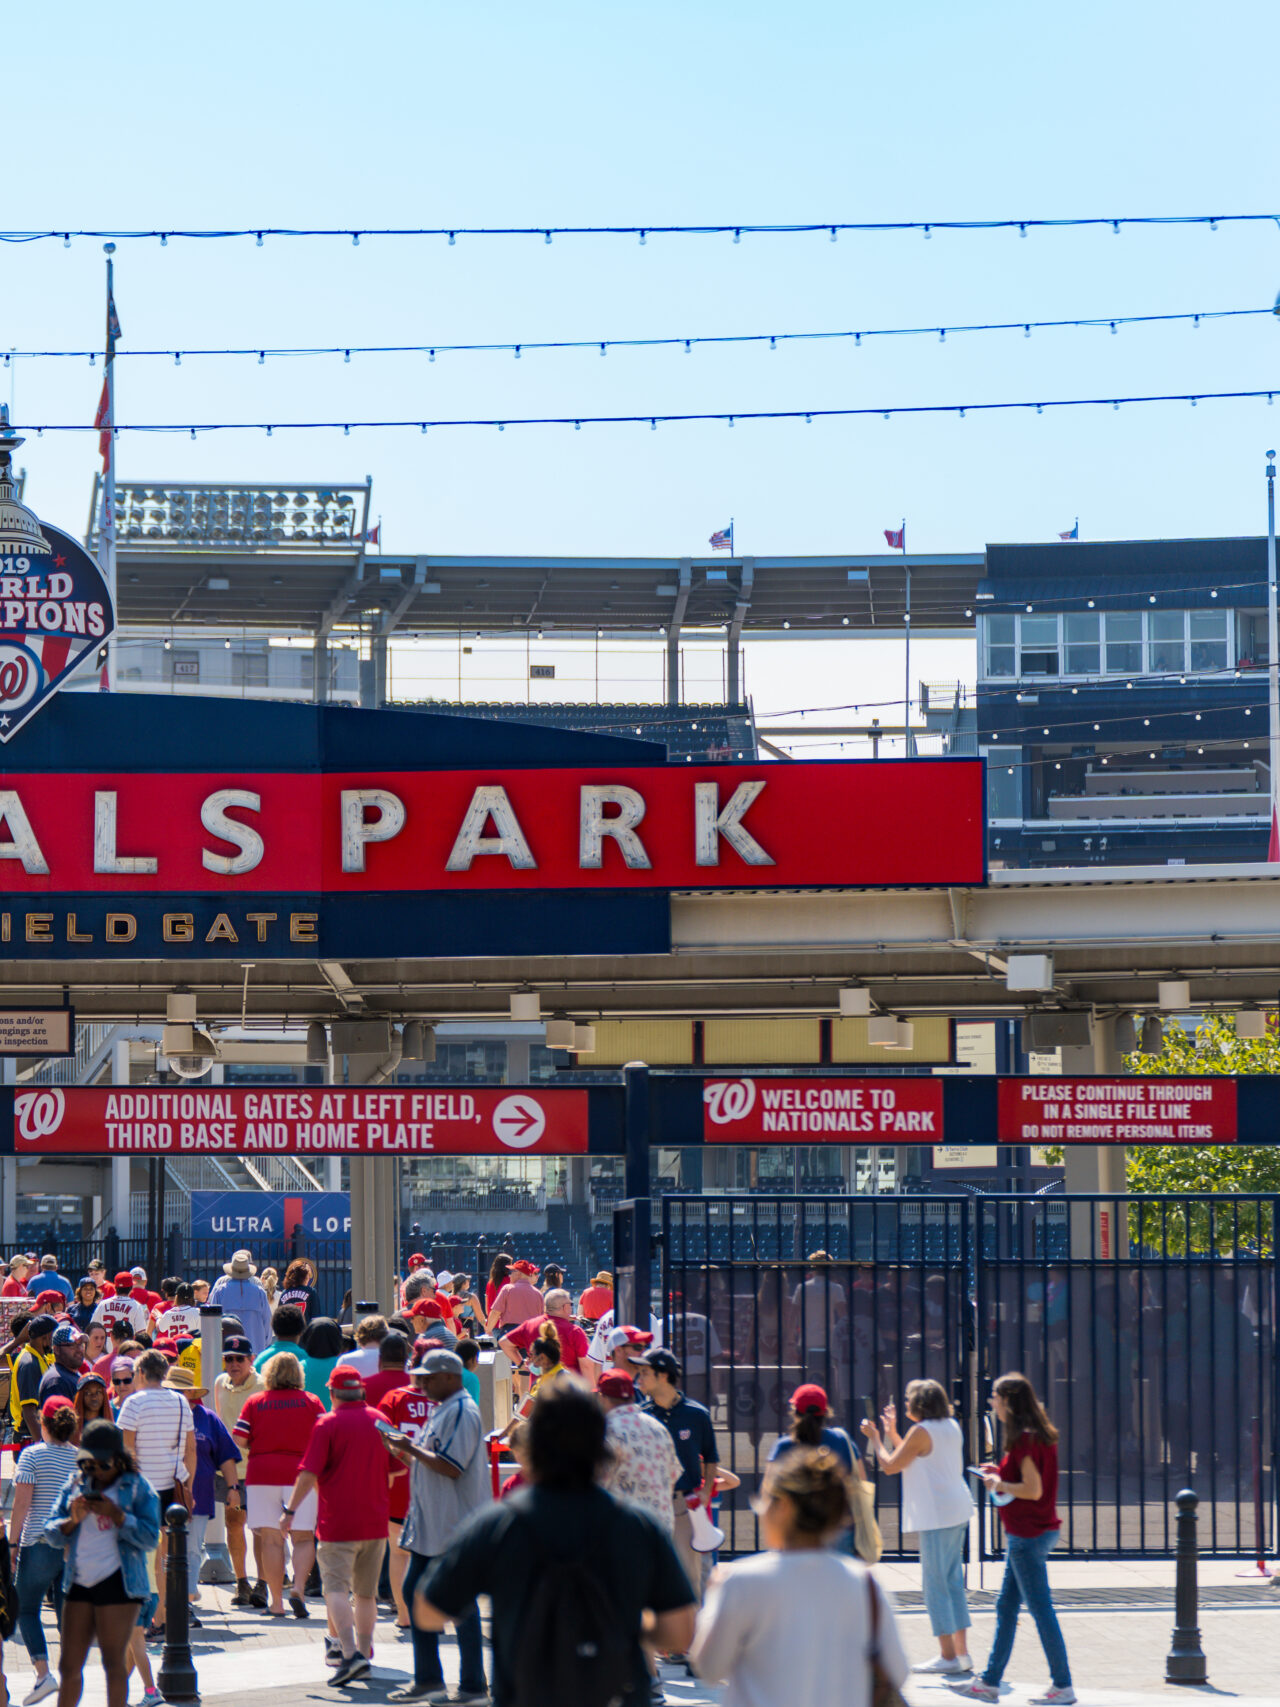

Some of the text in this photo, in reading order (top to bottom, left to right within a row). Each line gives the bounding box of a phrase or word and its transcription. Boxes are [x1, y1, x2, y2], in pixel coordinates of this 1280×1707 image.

[340, 780, 776, 874] PARK
[162, 911, 319, 943] GATE
[16, 1016, 44, 1025] and/or
[4, 1036, 48, 1047] inspection
[761, 1089, 896, 1110] WELCOME TO
[1021, 1084, 1213, 1101] PLEASE CONTINUE THROUGH
[105, 1093, 482, 1123] ADDITIONAL GATES AT LEFT FIELD,
[1043, 1103, 1192, 1119] IN A SINGLE FILE LINE
[763, 1111, 935, 1132] NATIONALS PARK
[104, 1122, 434, 1149] THIRD BASE AND HOME PLATE
[1022, 1124, 1213, 1138] DO NOT REMOVE PERSONAL ITEMS
[211, 1216, 273, 1233] ULTRA
[104, 1304, 132, 1314] LOGAN
[257, 1399, 306, 1412] NATIONALS
